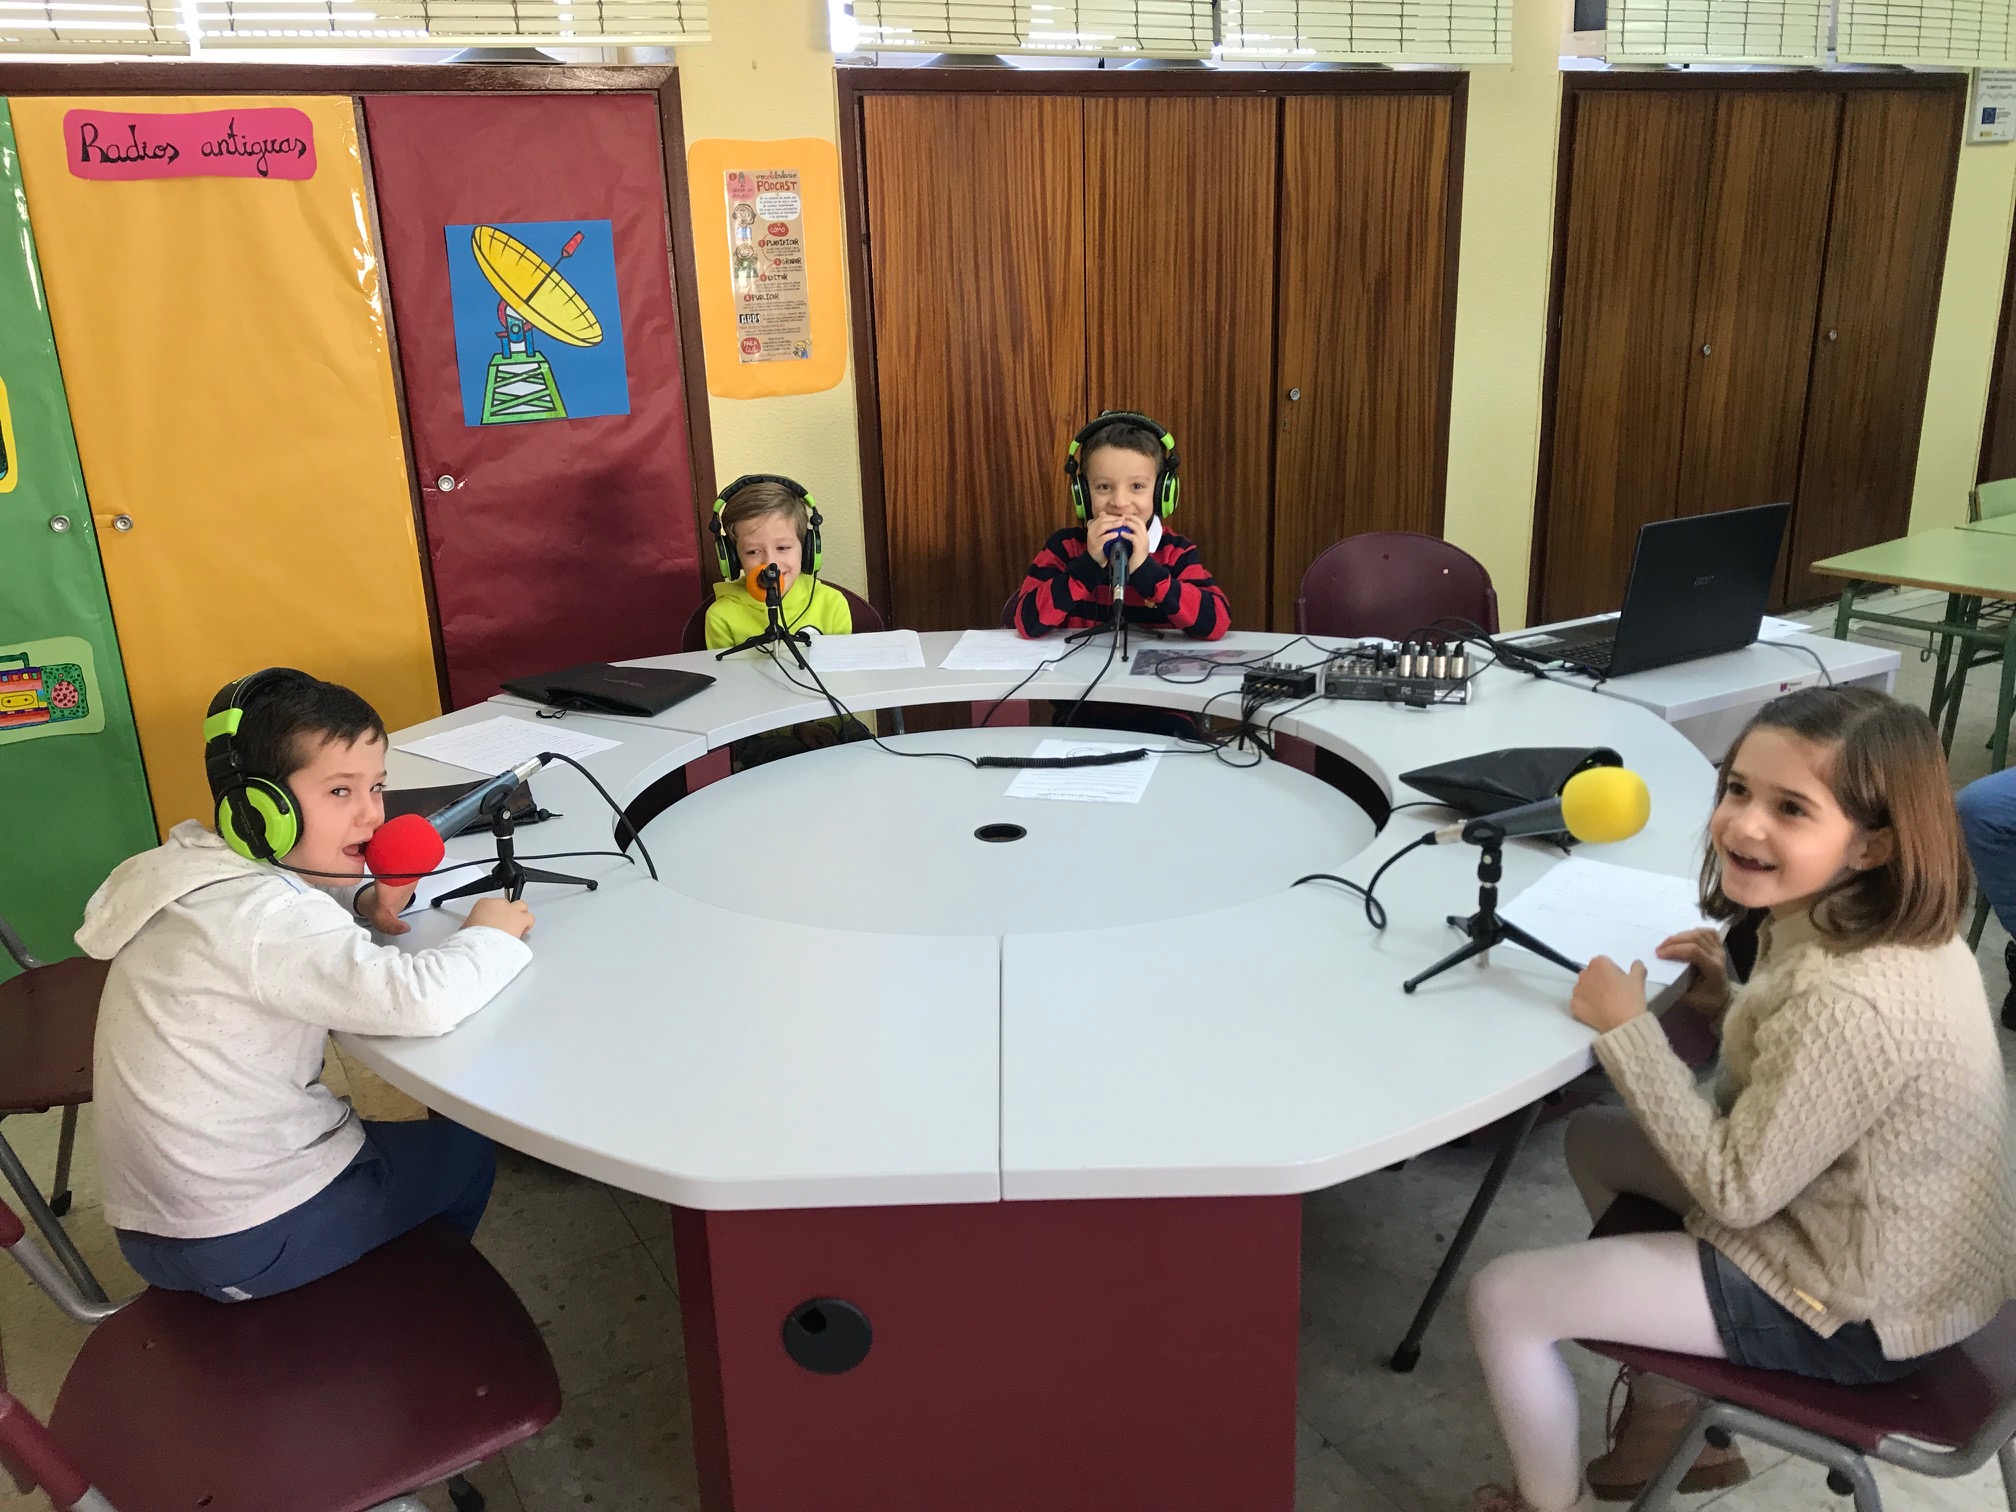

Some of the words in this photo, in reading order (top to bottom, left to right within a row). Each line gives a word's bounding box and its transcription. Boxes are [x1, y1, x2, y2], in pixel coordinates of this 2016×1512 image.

[80, 122, 180, 165] Radios
[201, 116, 307, 178] antiguas
[757, 181, 797, 192] PODCAST
[767, 273, 788, 281] EDITAR
[751, 293, 780, 301] PUBLICAR
[740, 313, 760, 324] APPS
